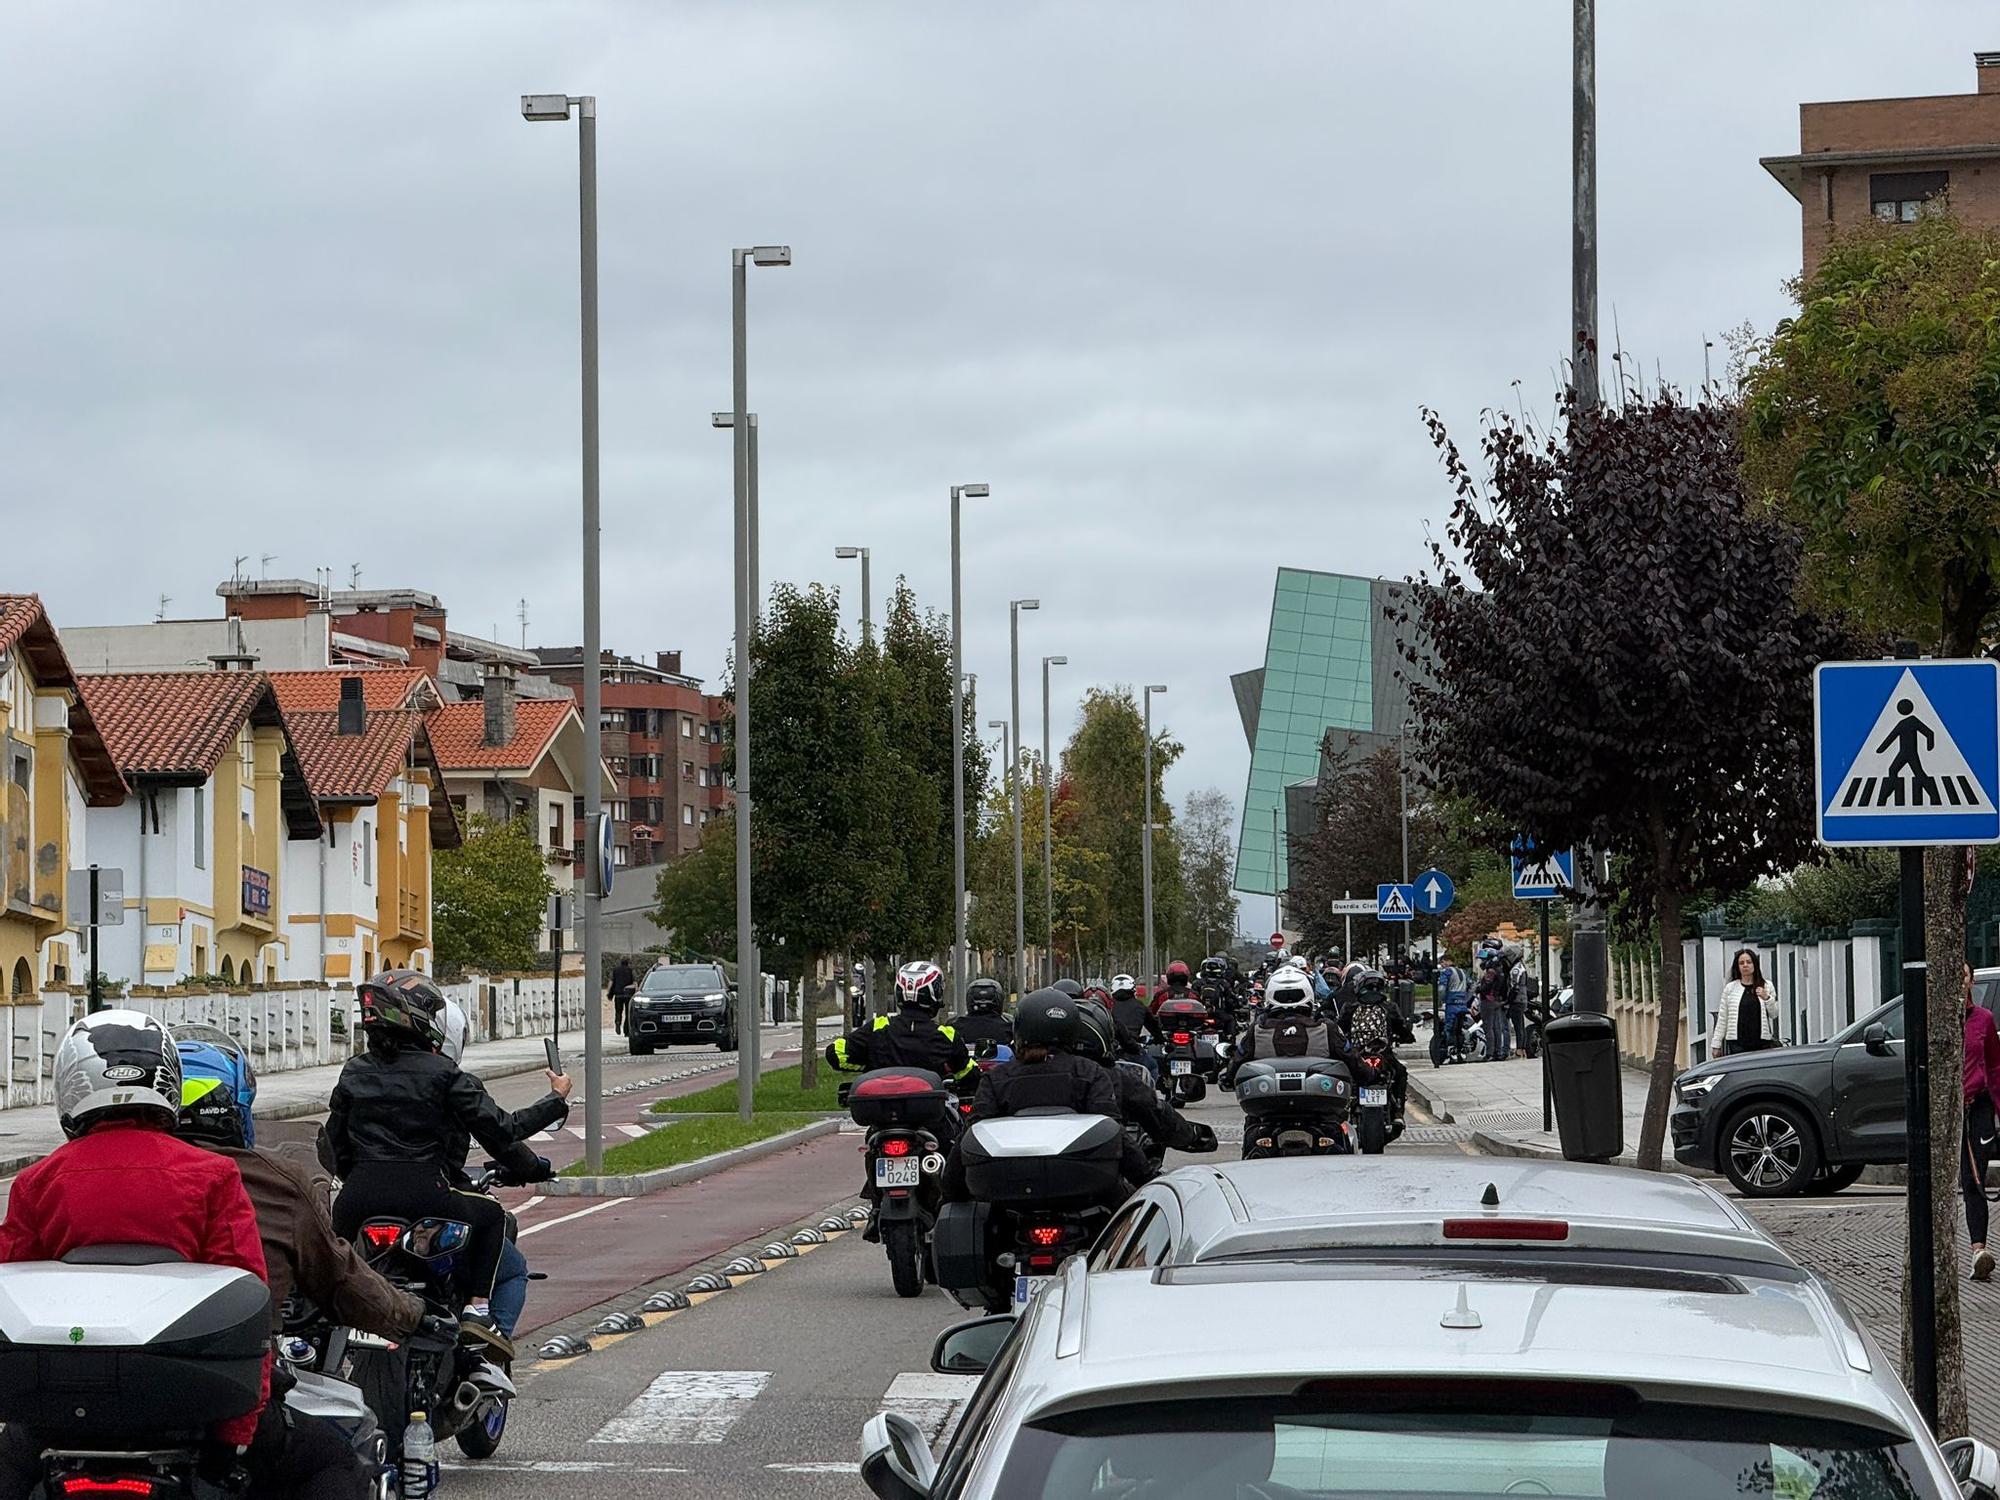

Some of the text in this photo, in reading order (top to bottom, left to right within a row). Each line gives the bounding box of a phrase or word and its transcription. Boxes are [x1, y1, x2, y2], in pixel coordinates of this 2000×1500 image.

[106, 1067, 142, 1078] HJC
[199, 1107, 220, 1115] DAVID
[887, 1158, 918, 1171] B XG
[887, 1171, 918, 1184] 0248
